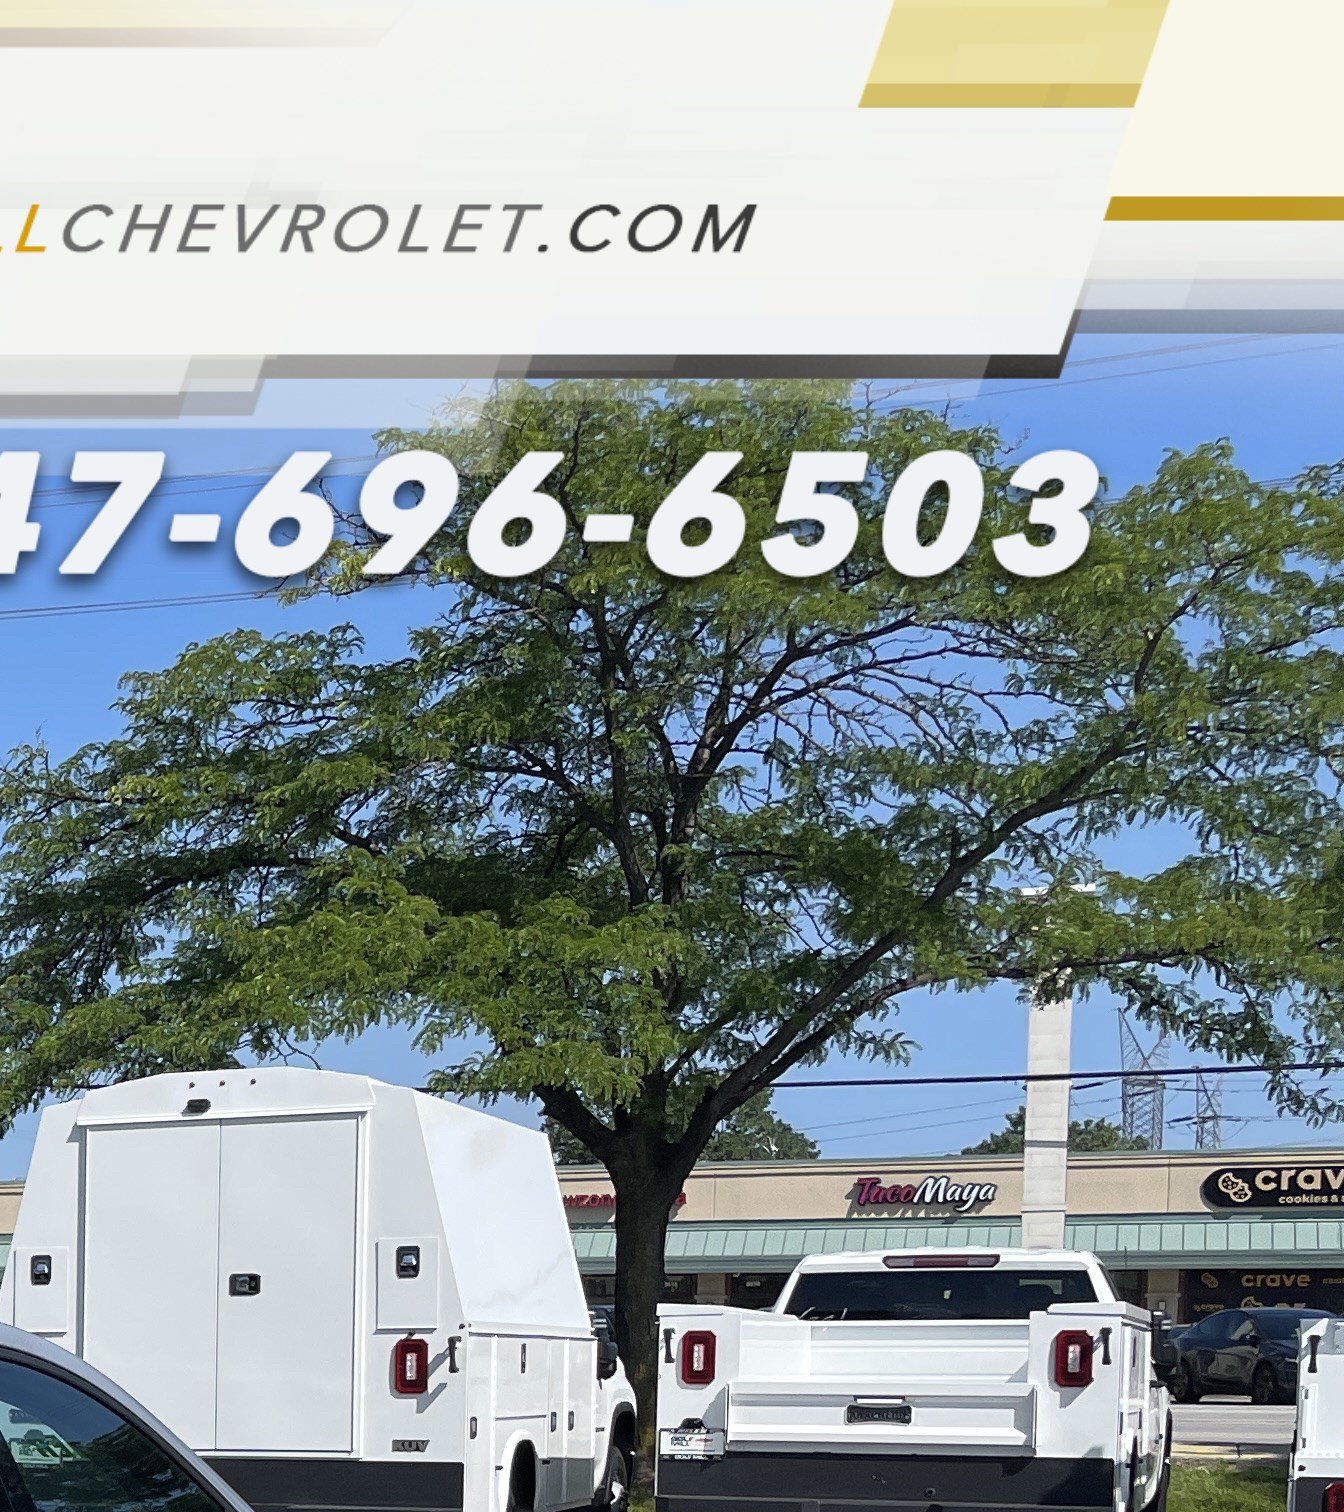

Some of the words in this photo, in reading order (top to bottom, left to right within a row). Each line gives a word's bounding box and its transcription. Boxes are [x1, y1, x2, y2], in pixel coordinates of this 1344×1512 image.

[1278, 1194, 1328, 1204] cookies
[1241, 1273, 1311, 1288] crave
[391, 1439, 431, 1453] KUV
